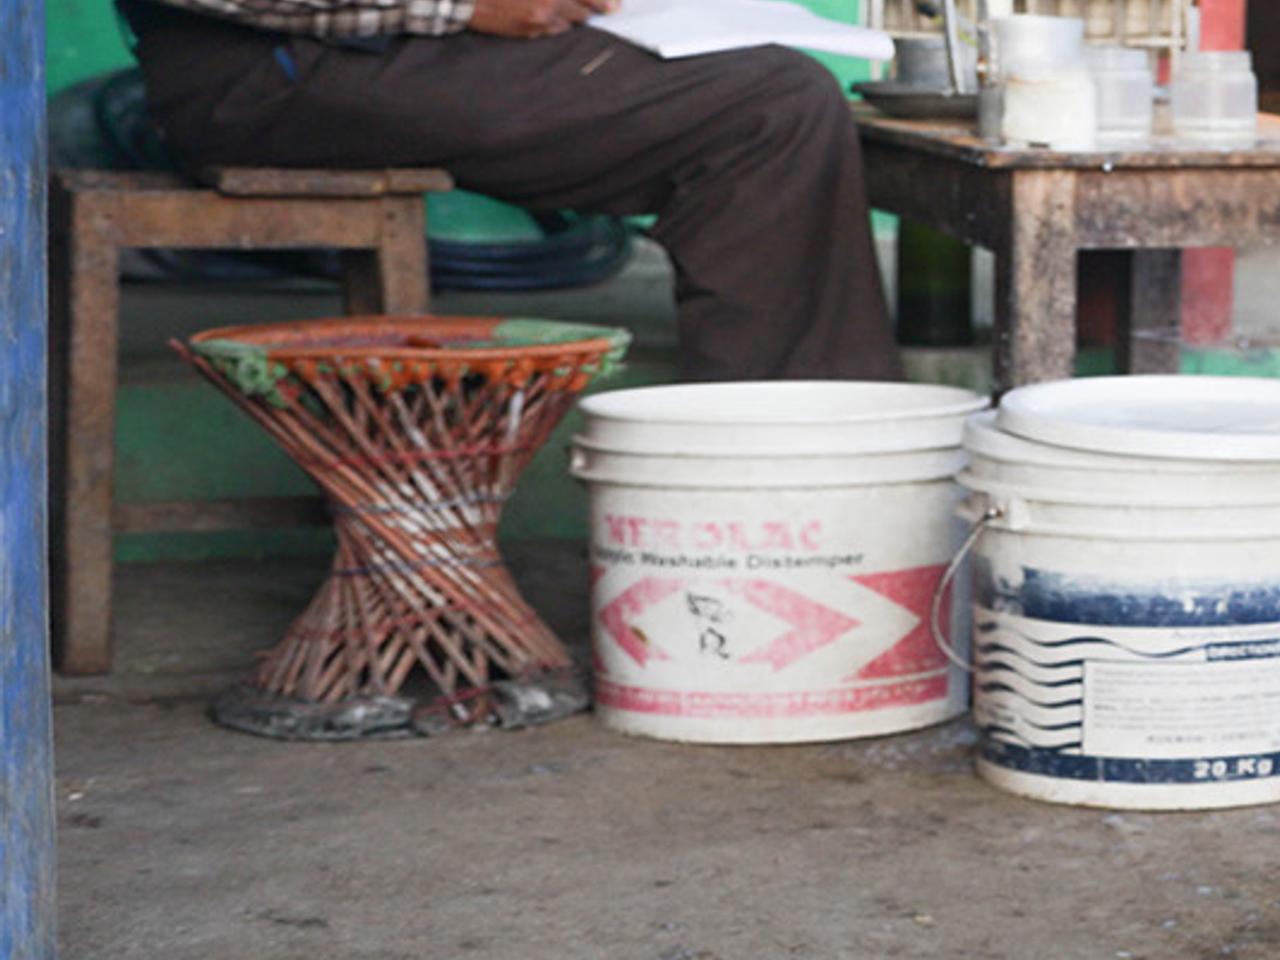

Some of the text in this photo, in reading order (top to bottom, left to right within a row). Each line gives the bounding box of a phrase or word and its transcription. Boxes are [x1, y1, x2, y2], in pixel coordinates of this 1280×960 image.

[639, 551, 737, 570] Washable
[746, 551, 865, 571] Distemper
[1192, 759, 1228, 779] 20
